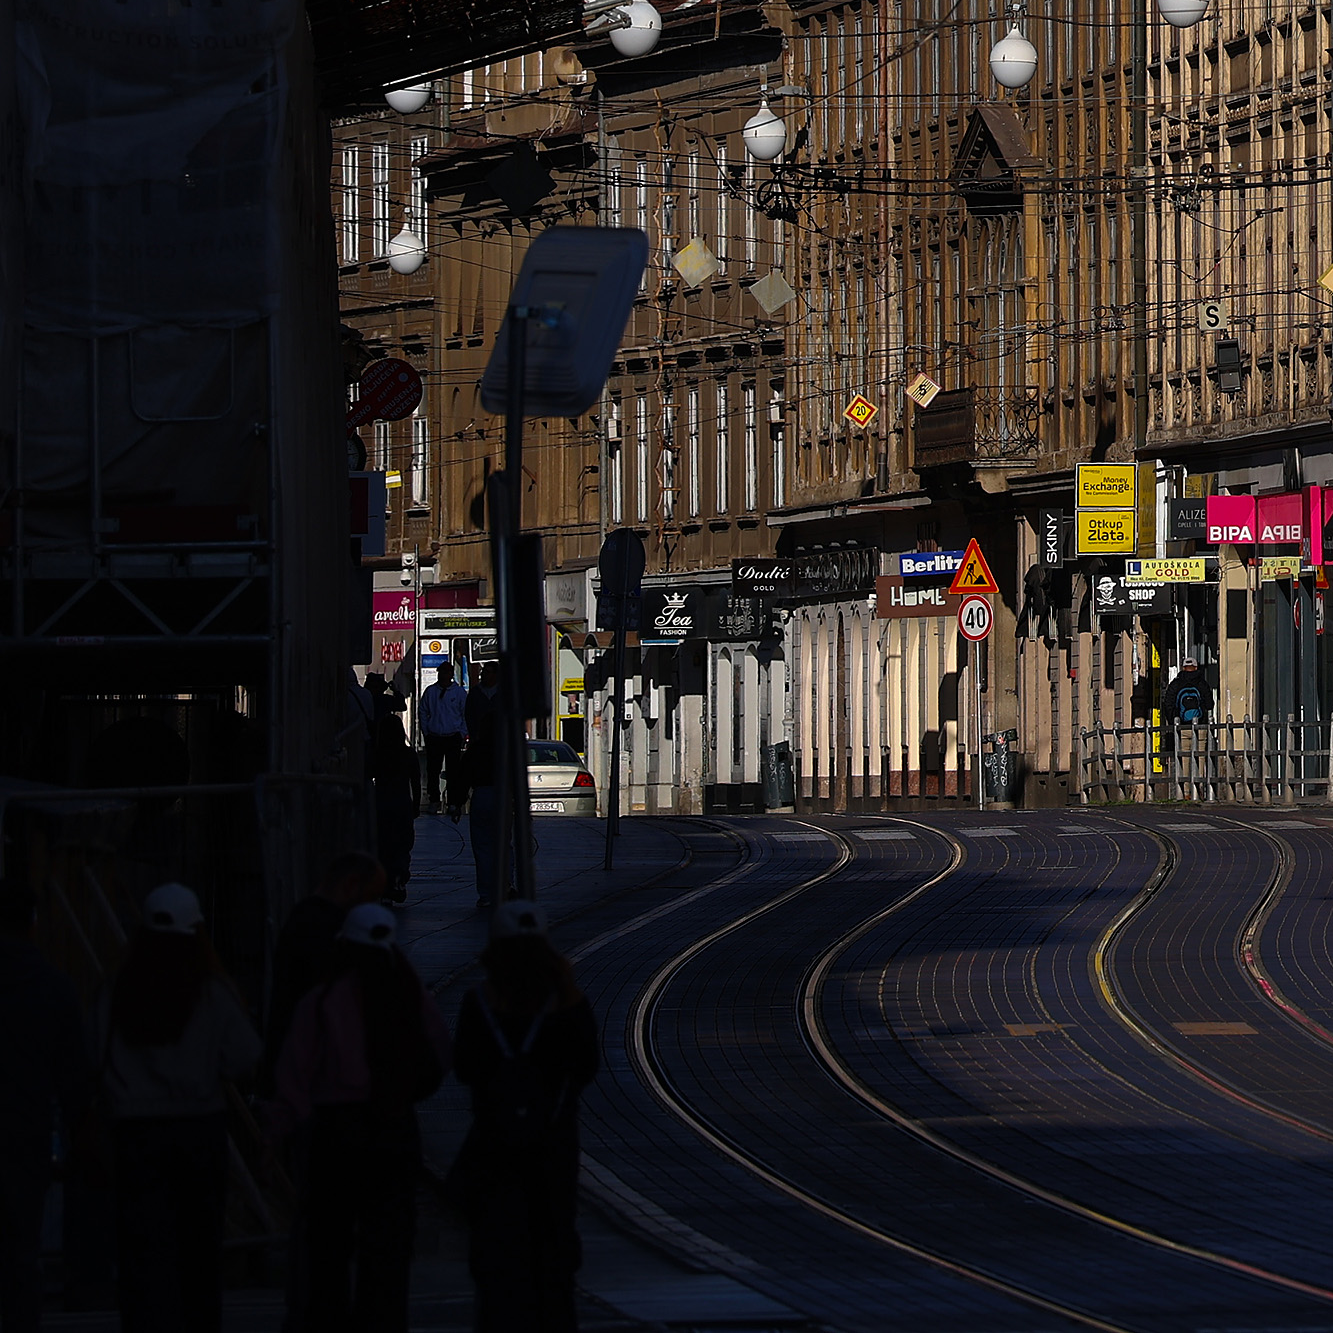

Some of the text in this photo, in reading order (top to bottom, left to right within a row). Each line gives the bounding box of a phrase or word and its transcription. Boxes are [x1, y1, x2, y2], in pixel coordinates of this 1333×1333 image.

[1205, 305, 1220, 327] S
[855, 405, 866, 416] 20
[1103, 476, 1128, 484] Money
[1089, 519, 1123, 530] Otkup
[1046, 513, 1058, 563] SKINY
[1088, 529, 1124, 541] Zlata
[1209, 525, 1253, 541] BIPA
[901, 555, 963, 574] Berlitz
[736, 565, 792, 580] Dodić
[1155, 568, 1190, 577] GOLD
[753, 584, 775, 592] GOLD
[1129, 589, 1155, 600] SHOP
[654, 604, 693, 626] Tea
[965, 607, 986, 629] 40
